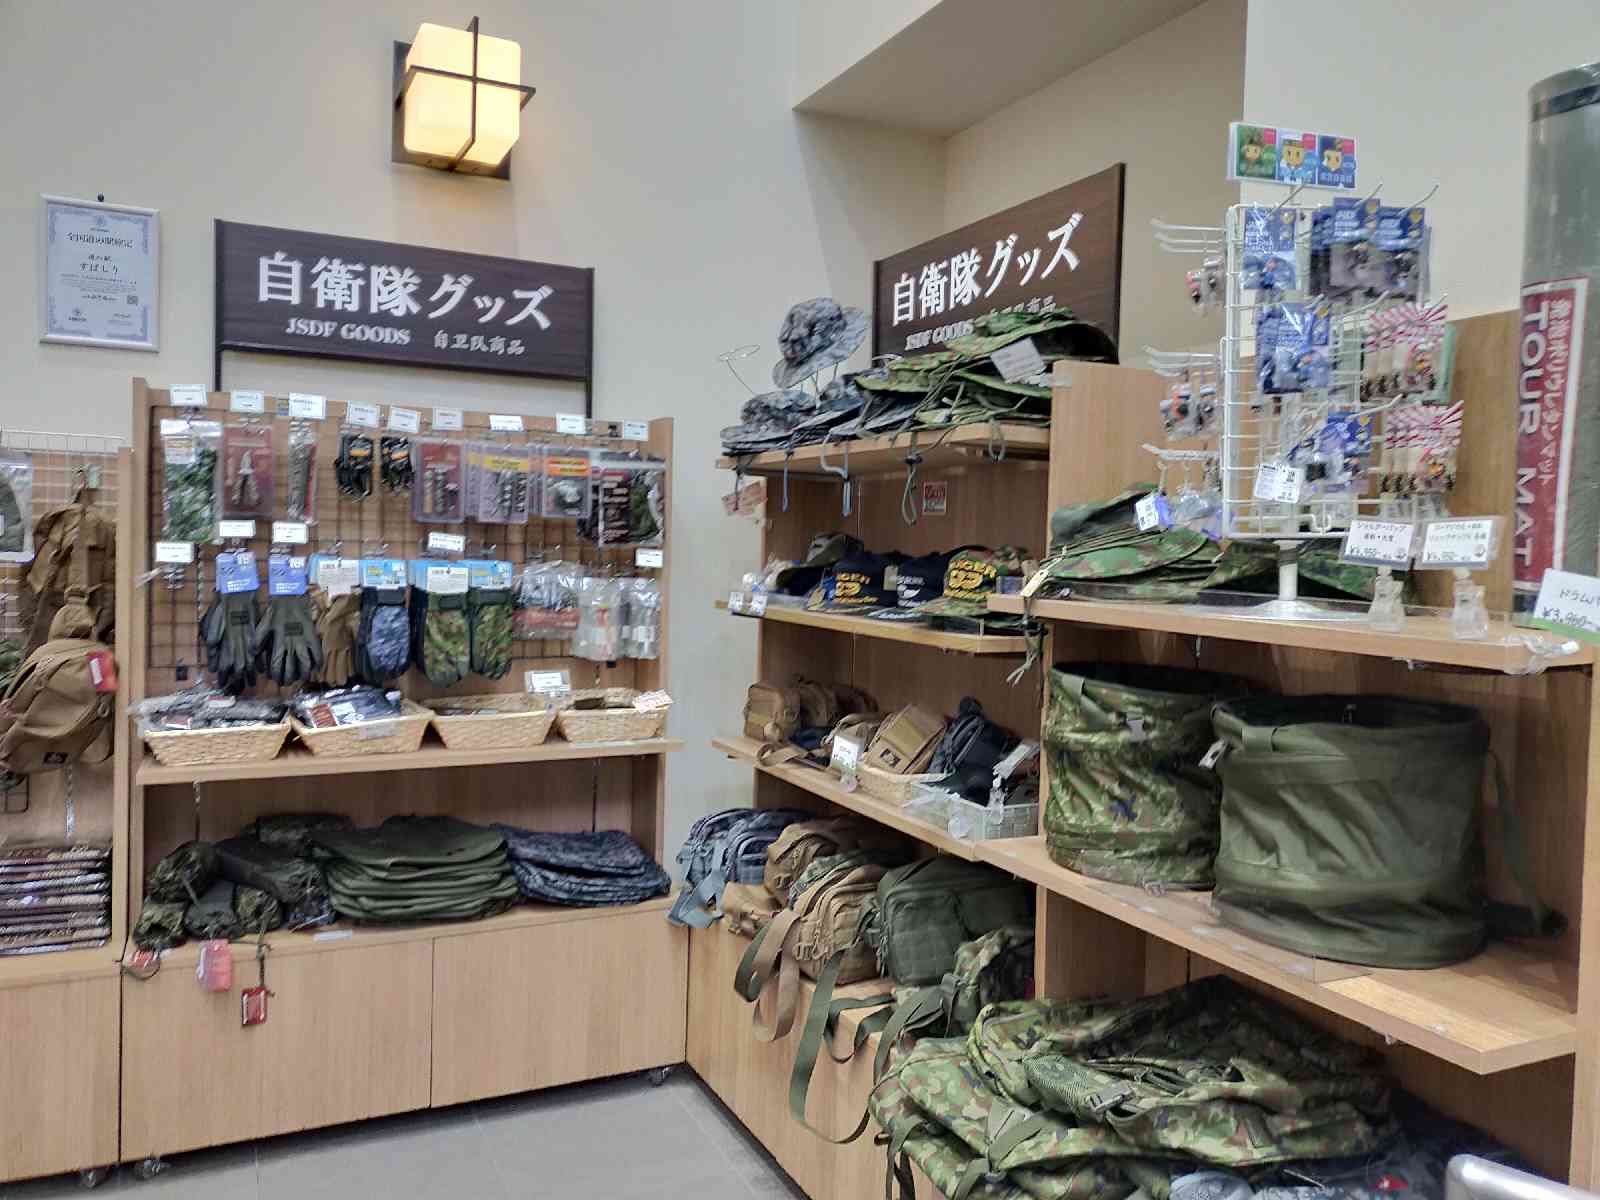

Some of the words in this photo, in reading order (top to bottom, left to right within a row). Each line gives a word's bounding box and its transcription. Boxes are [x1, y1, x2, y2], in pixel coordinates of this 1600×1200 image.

[257, 250, 554, 330] 自衛隊グッズ
[892, 212, 1083, 326] 自衛隊グッズ
[285, 317, 338, 337] JSDF
[340, 322, 411, 345] GOODS
[433, 329, 526, 356] 自卫队商品
[1519, 300, 1549, 437] TOUR
[1538, 298, 1570, 487] 発泡ポリウレタンマット
[1514, 466, 1537, 567] MAT
